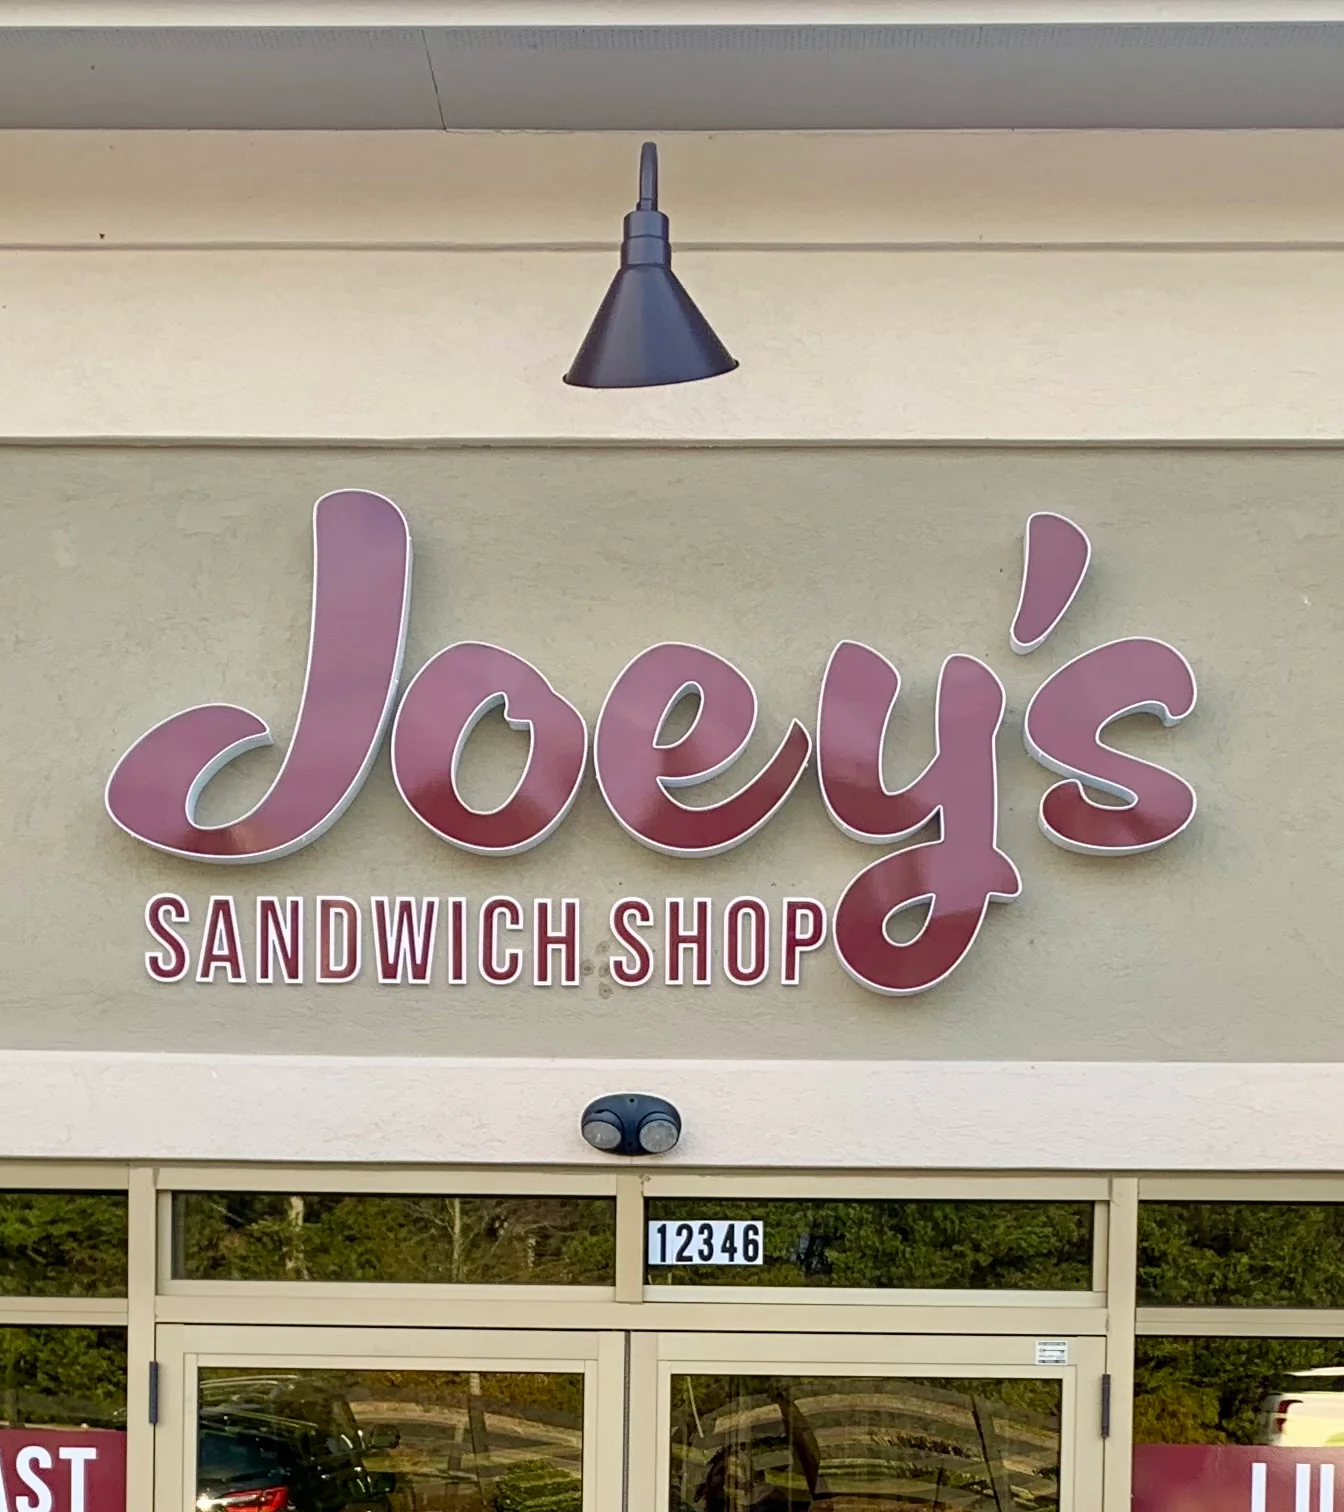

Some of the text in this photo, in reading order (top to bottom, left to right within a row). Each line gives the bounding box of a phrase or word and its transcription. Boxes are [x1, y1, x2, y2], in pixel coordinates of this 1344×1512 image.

[105, 488, 1197, 996] Joey's
[145, 892, 826, 987] SANDWICH SHOP
[656, 1222, 760, 1263] 12346
